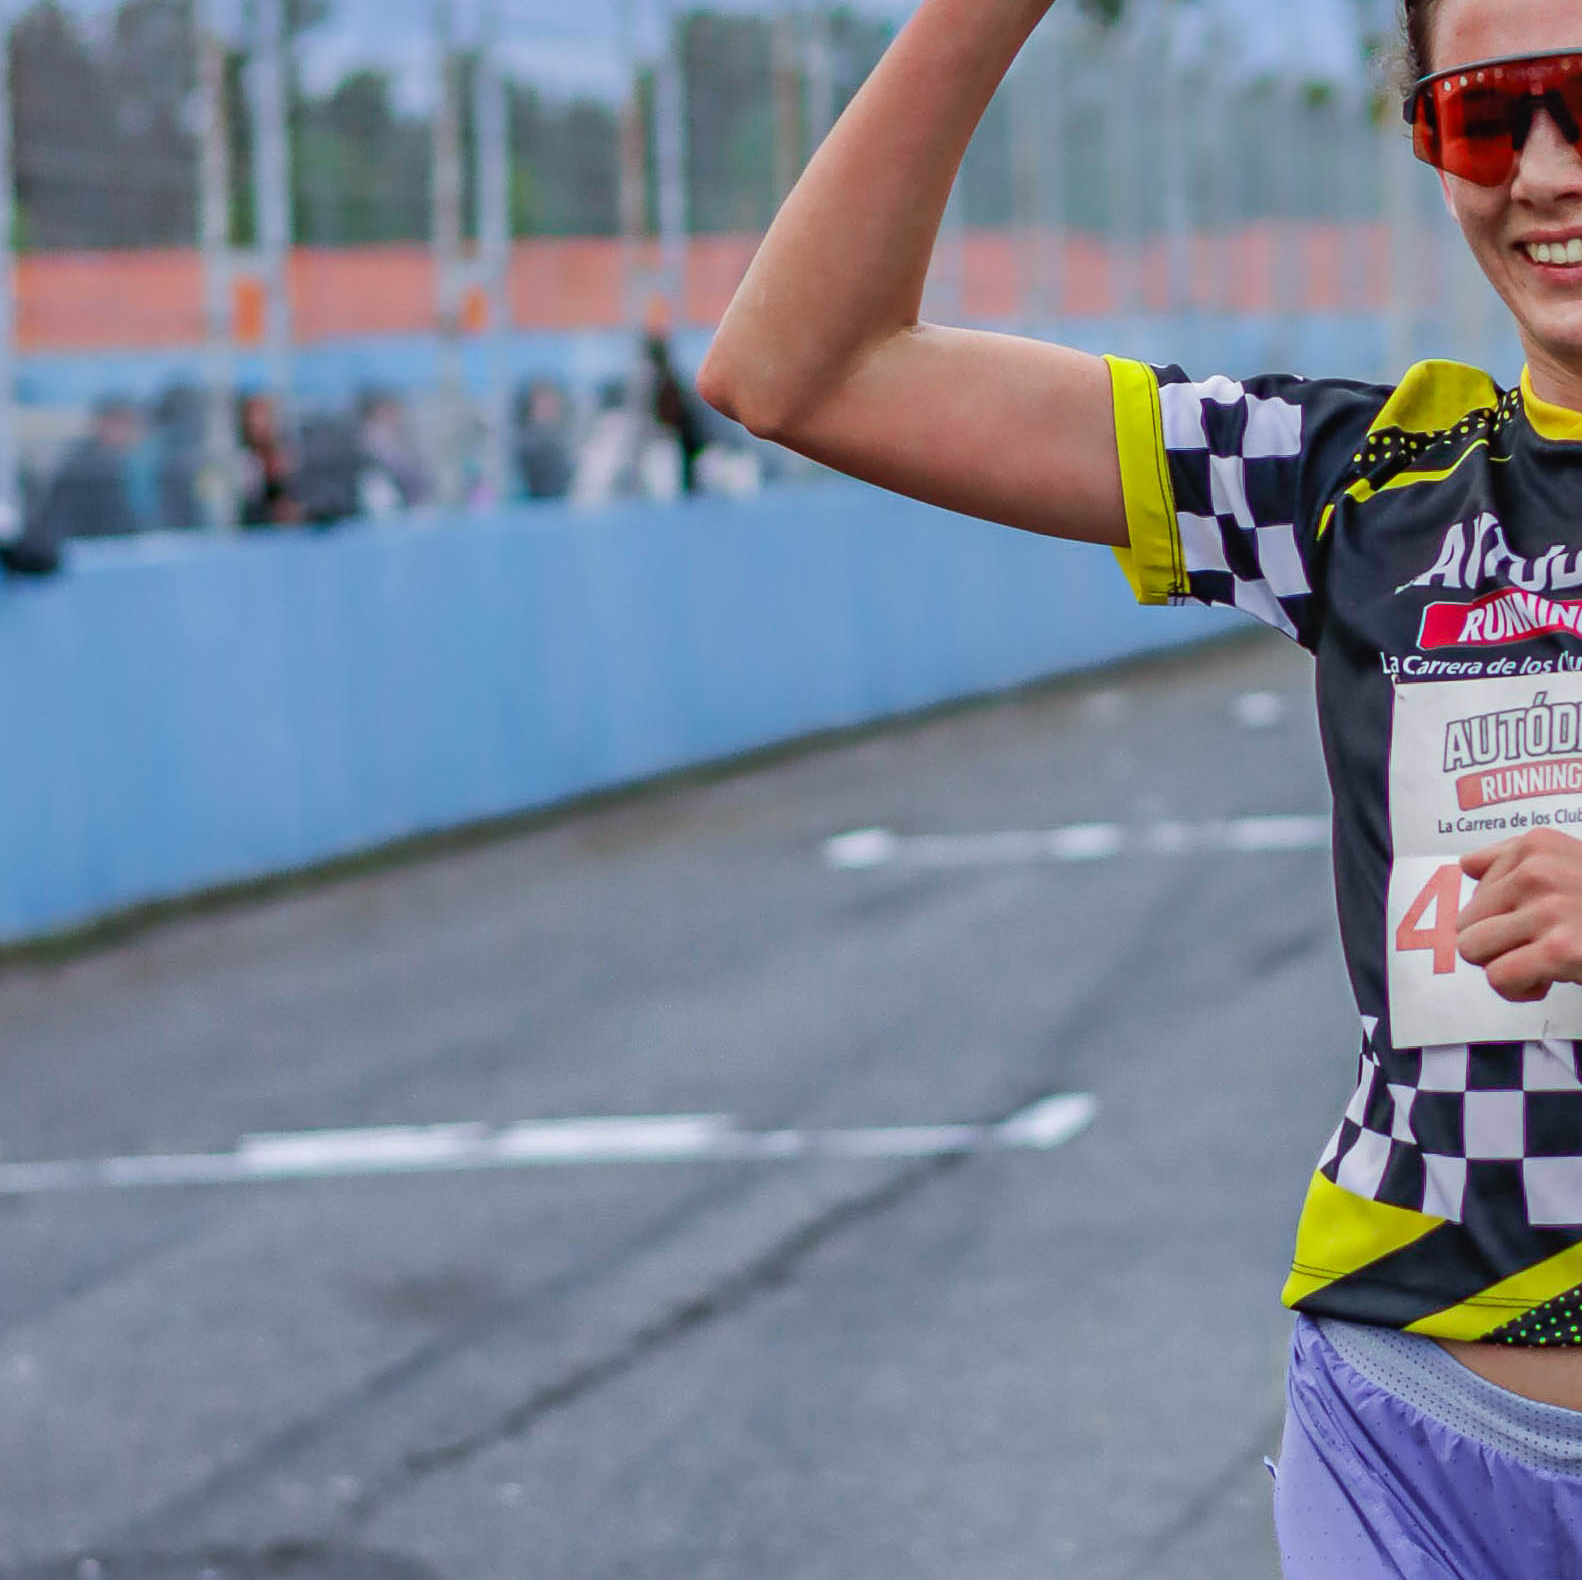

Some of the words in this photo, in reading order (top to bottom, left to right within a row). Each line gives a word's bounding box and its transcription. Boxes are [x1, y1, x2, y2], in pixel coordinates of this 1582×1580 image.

[1380, 652, 1400, 674] La
[1402, 655, 1484, 676] Carrera
[1486, 657, 1518, 675] de
[1519, 656, 1553, 674] los
[1480, 762, 1582, 803] RUNNING
[1438, 819, 1453, 834] La
[1456, 816, 1507, 832] Carrera
[1510, 813, 1528, 827] de
[1531, 811, 1551, 825] los
